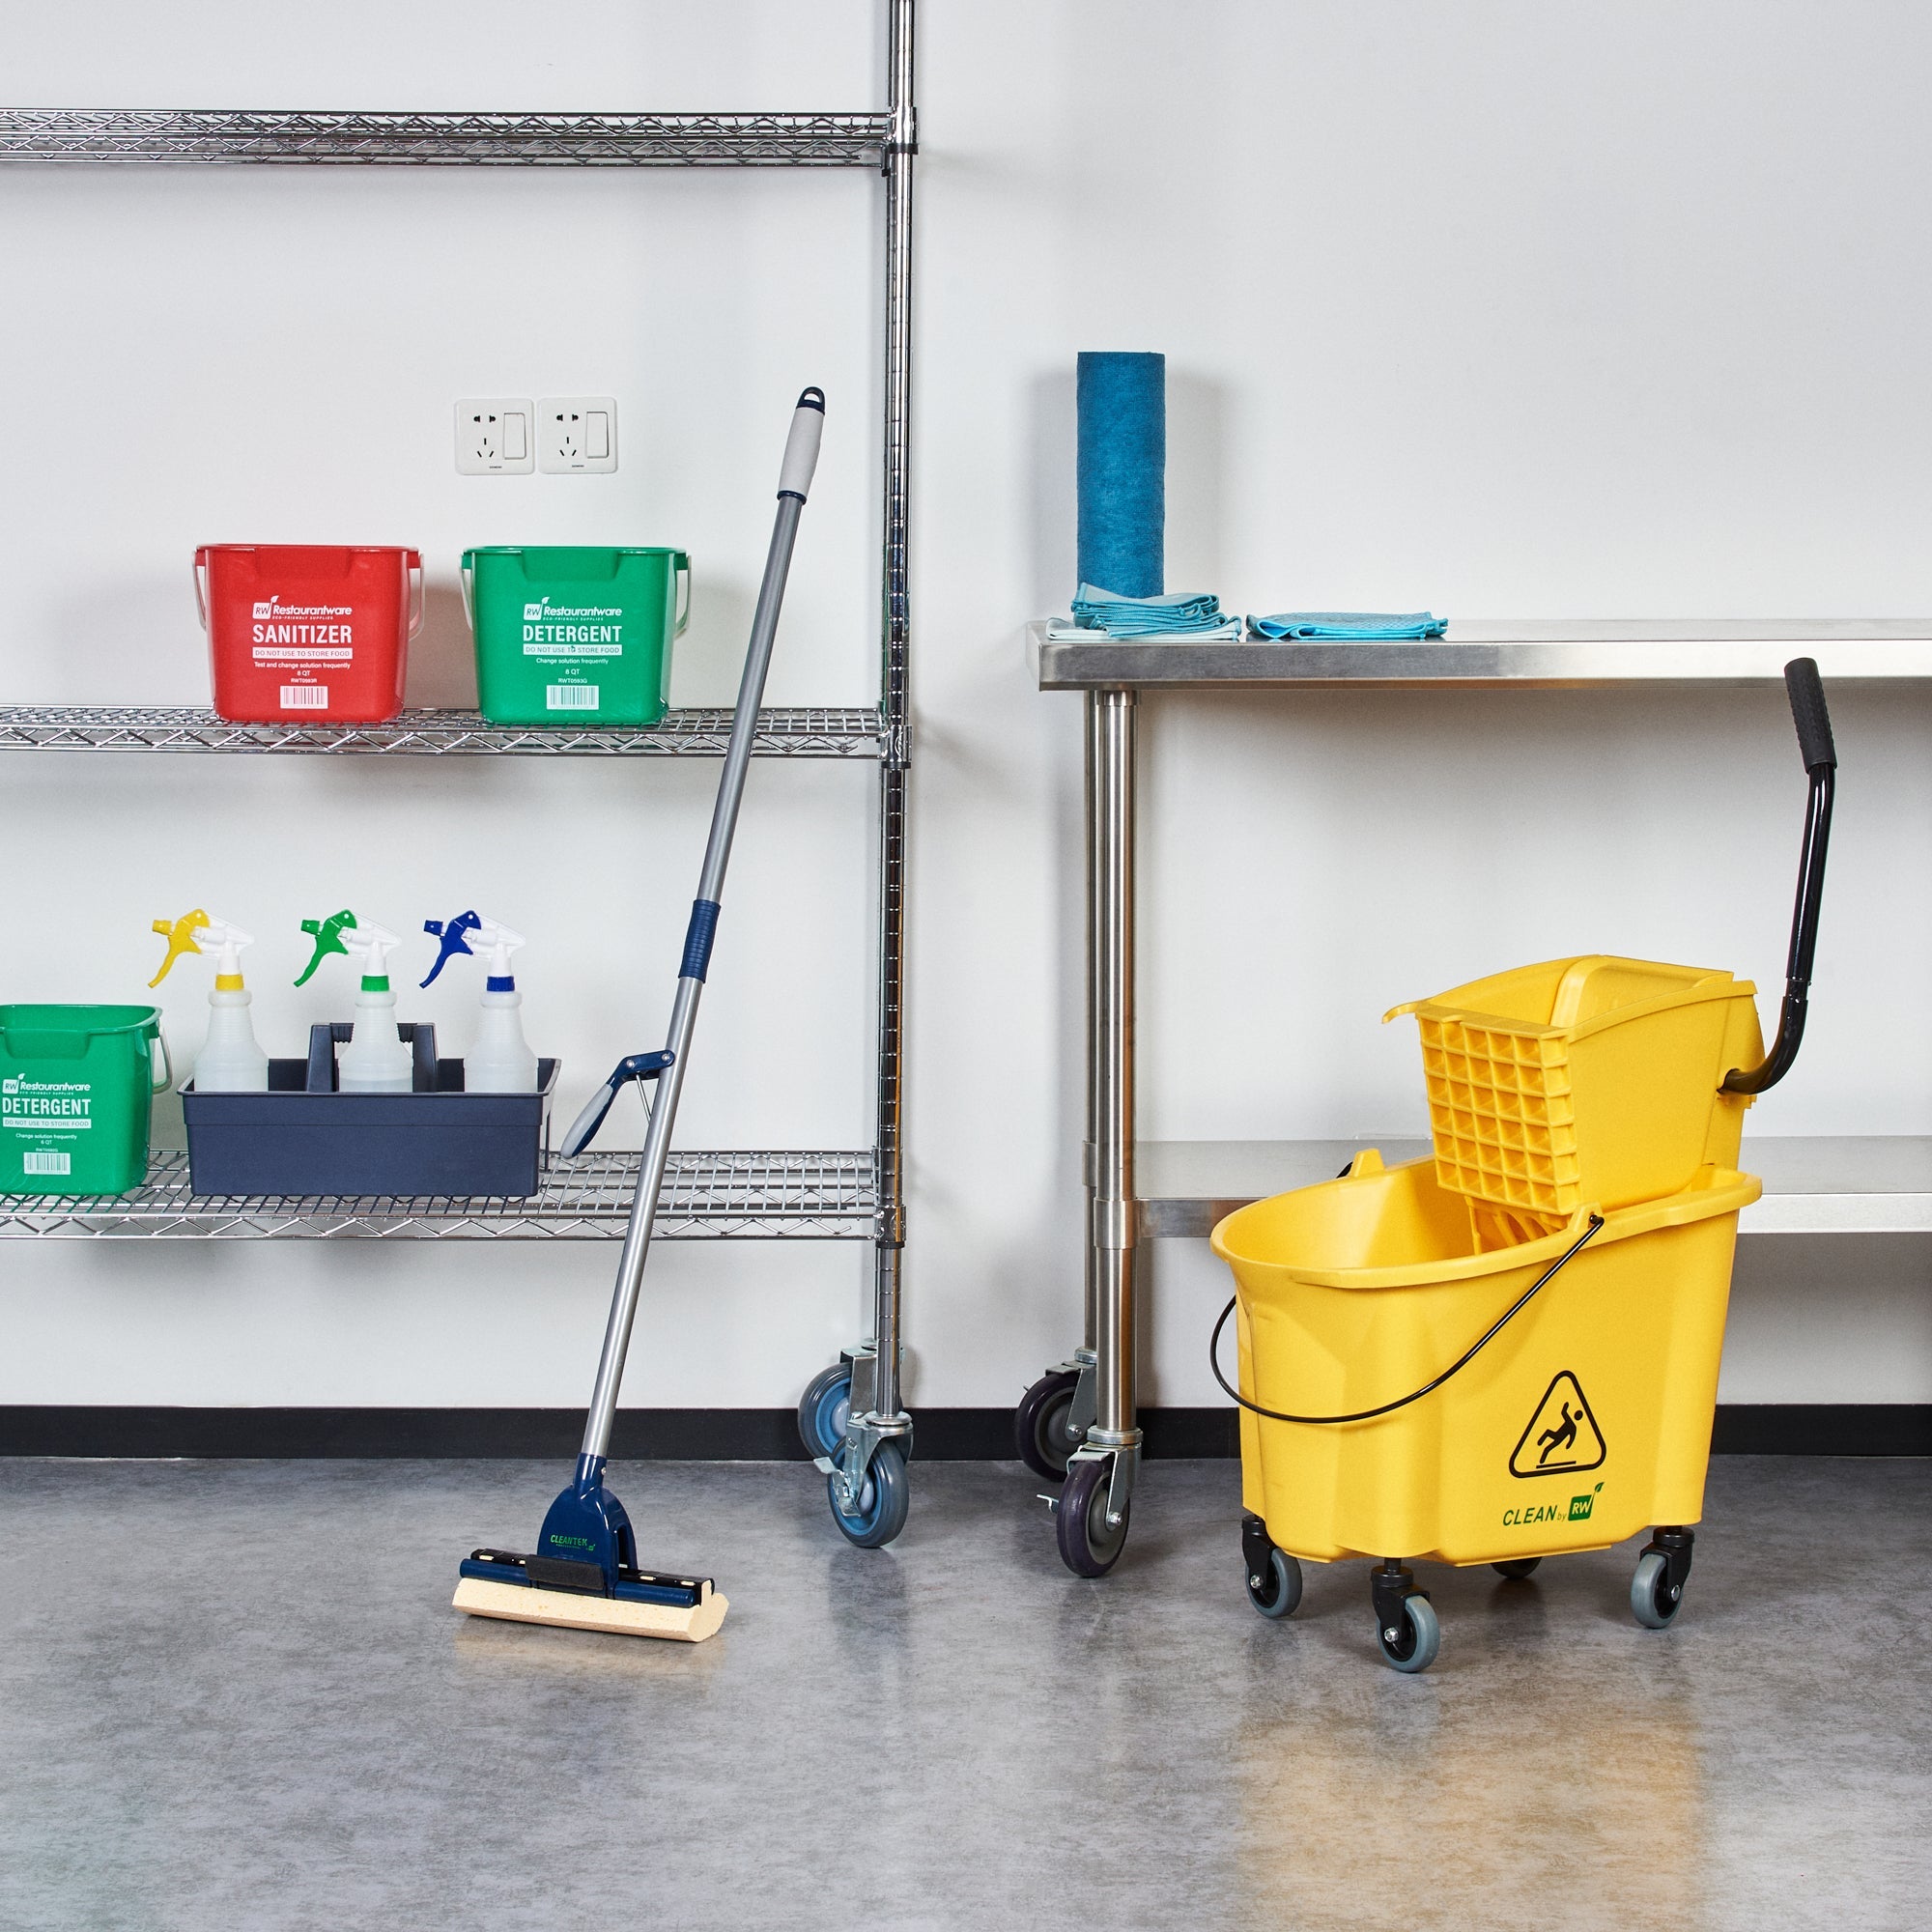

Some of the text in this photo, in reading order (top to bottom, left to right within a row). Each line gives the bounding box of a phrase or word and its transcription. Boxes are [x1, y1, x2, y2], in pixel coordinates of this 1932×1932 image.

[255, 605, 353, 615] RW Restaurantware
[544, 606, 623, 616] Restaurantware
[252, 624, 353, 643] SANITIZER
[523, 625, 623, 642] DETERGENT
[19, 1081, 91, 1092] Restaurantware
[2, 1097, 92, 1115] DETERGENT
[1502, 1501, 1591, 1526] CLEAN by RW
[550, 1534, 588, 1547] CLEANTEK
